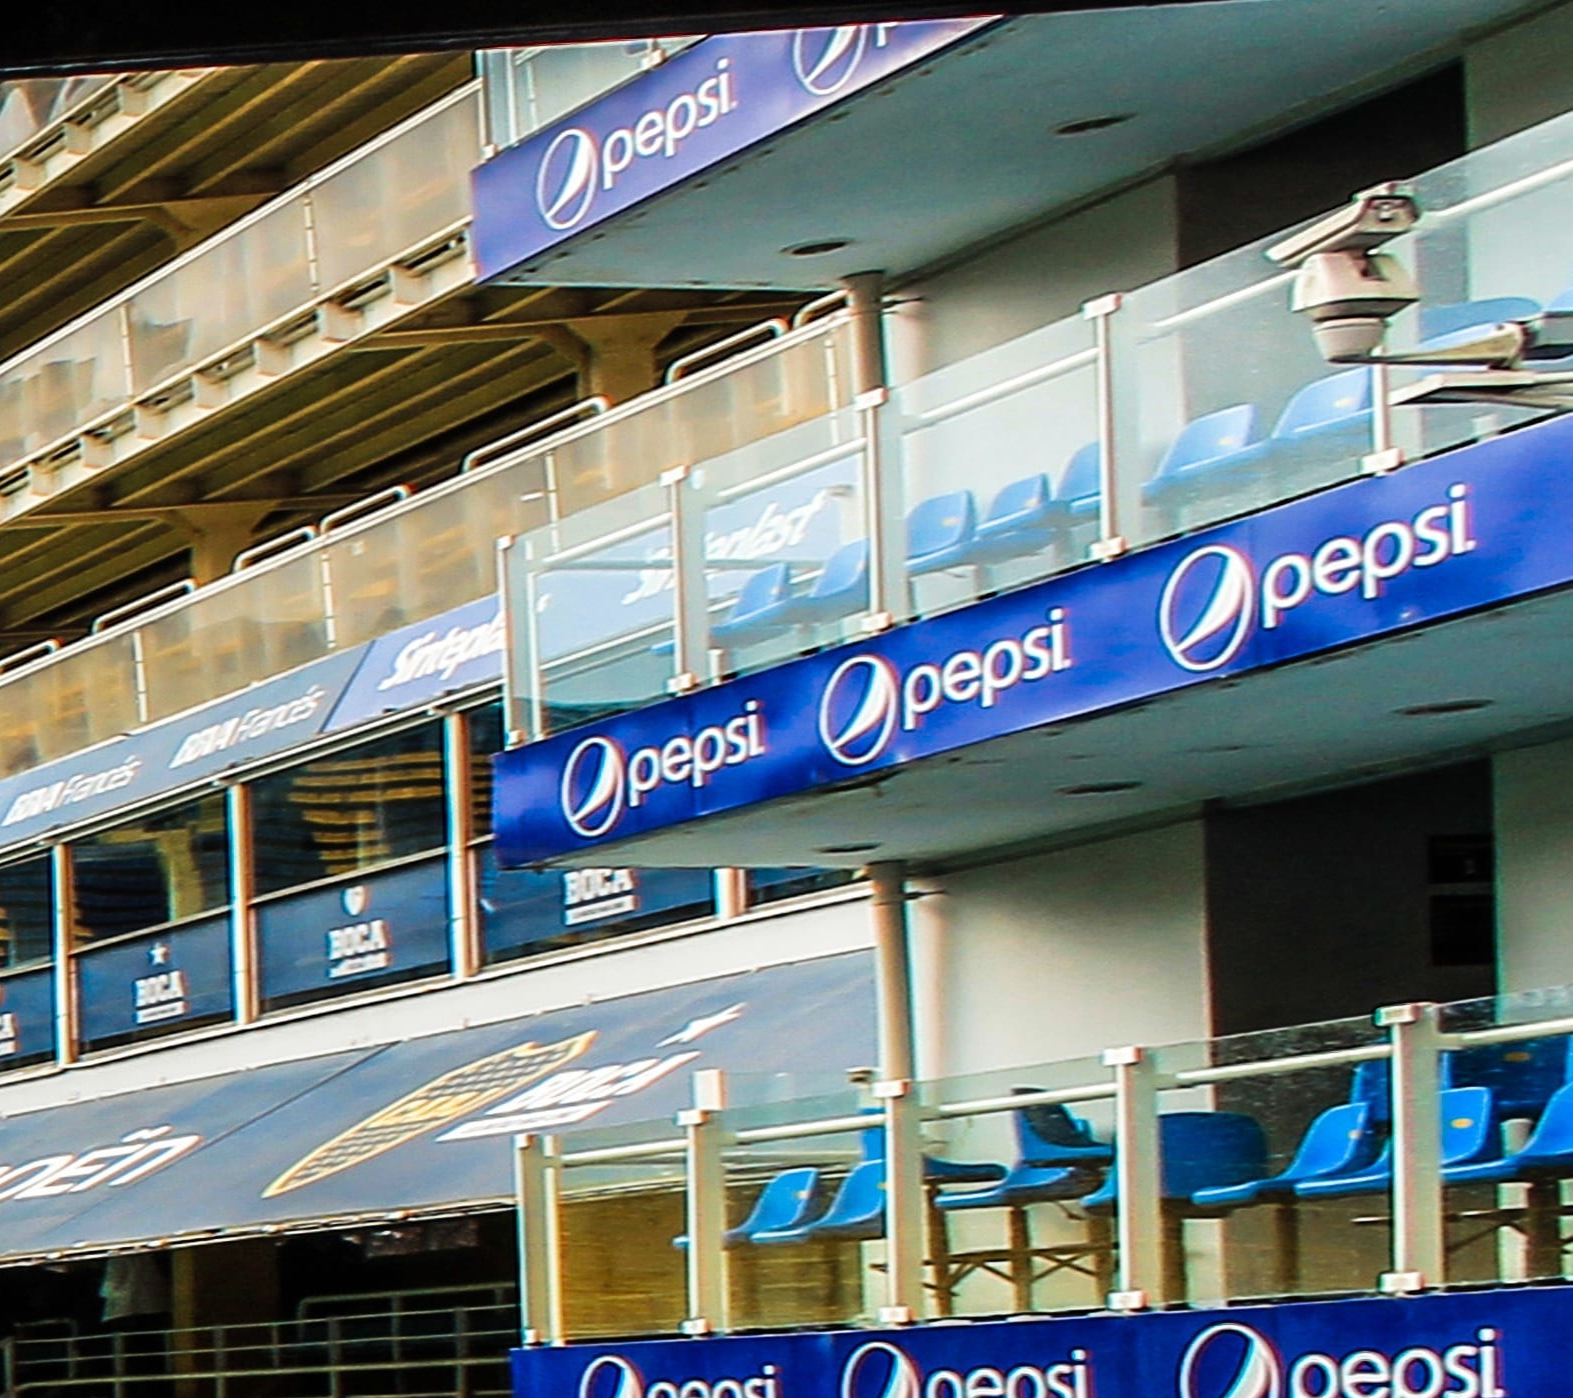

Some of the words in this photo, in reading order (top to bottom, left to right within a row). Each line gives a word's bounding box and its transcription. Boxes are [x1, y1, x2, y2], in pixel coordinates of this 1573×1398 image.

[602, 59, 738, 190] pepsi
[1261, 482, 1475, 631] pepsi
[902, 610, 1072, 729] pepsi
[628, 699, 767, 800] pepsi
[327, 919, 389, 960] BOCA
